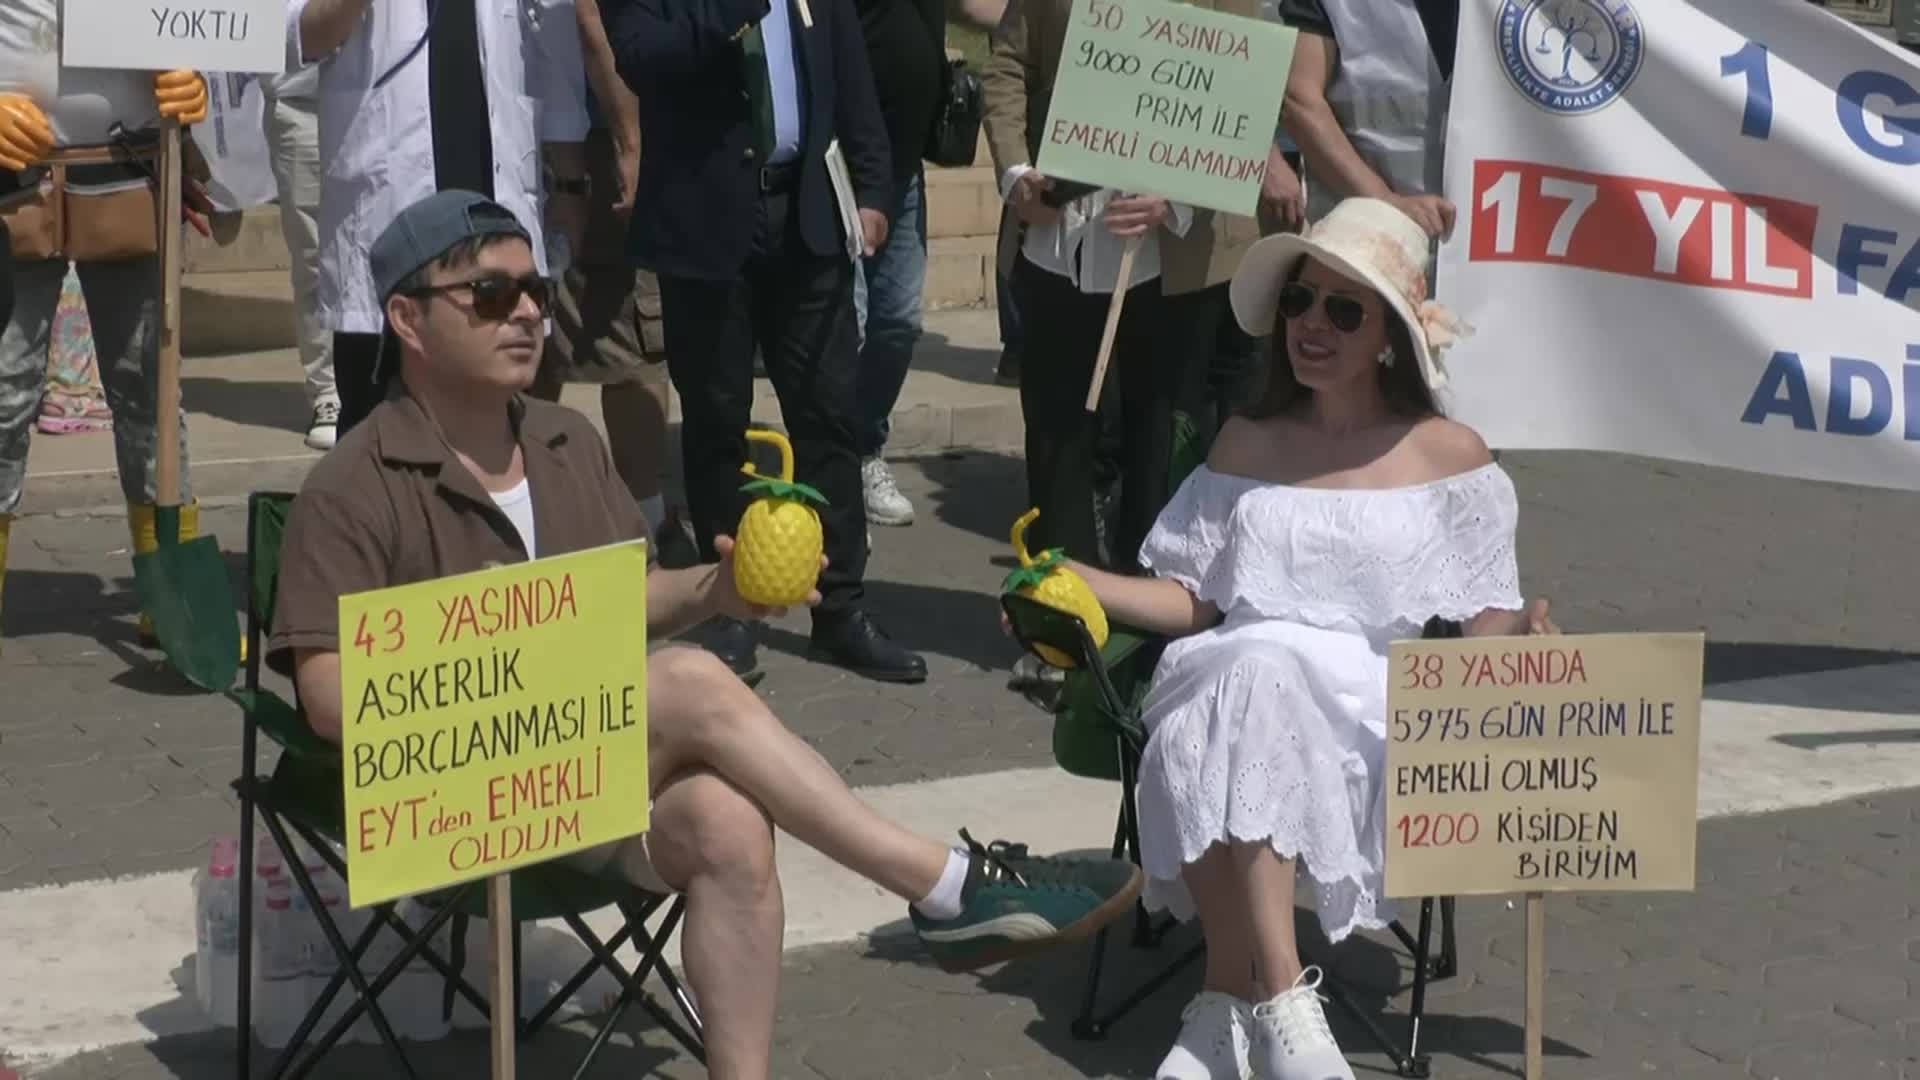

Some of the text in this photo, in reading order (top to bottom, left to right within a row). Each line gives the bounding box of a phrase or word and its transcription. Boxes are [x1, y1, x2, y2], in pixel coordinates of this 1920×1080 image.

[151, 8, 248, 41] YOKTU
[1082, 0, 1125, 32] 50
[1075, 40, 1214, 92] 9000 GÜN
[1553, 87, 1606, 107] ADALET
[1720, 41, 1920, 166] 1 G
[1212, 104, 1249, 141] İLE
[1051, 119, 1266, 184] EMEKLİ OLAMADIM
[1481, 170, 1598, 257] 17
[1635, 189, 1799, 289] YIL
[354, 573, 577, 657] 43 YAŞINDA
[356, 646, 524, 724] ASKERLİK
[1400, 653, 1443, 690] 38
[354, 684, 636, 788] BORÇLANMASI İLE
[1393, 697, 1674, 743] 5975 GÜN PRİM İLE
[359, 746, 602, 853] EYT'den EMEKLİ
[1396, 754, 1598, 796] EMEKLİ OLMUŞ
[449, 810, 581, 871] OLDUM
[1396, 806, 1617, 848] 1200 KİŞİDEN
[1513, 845, 1638, 880] BİRİYİM
